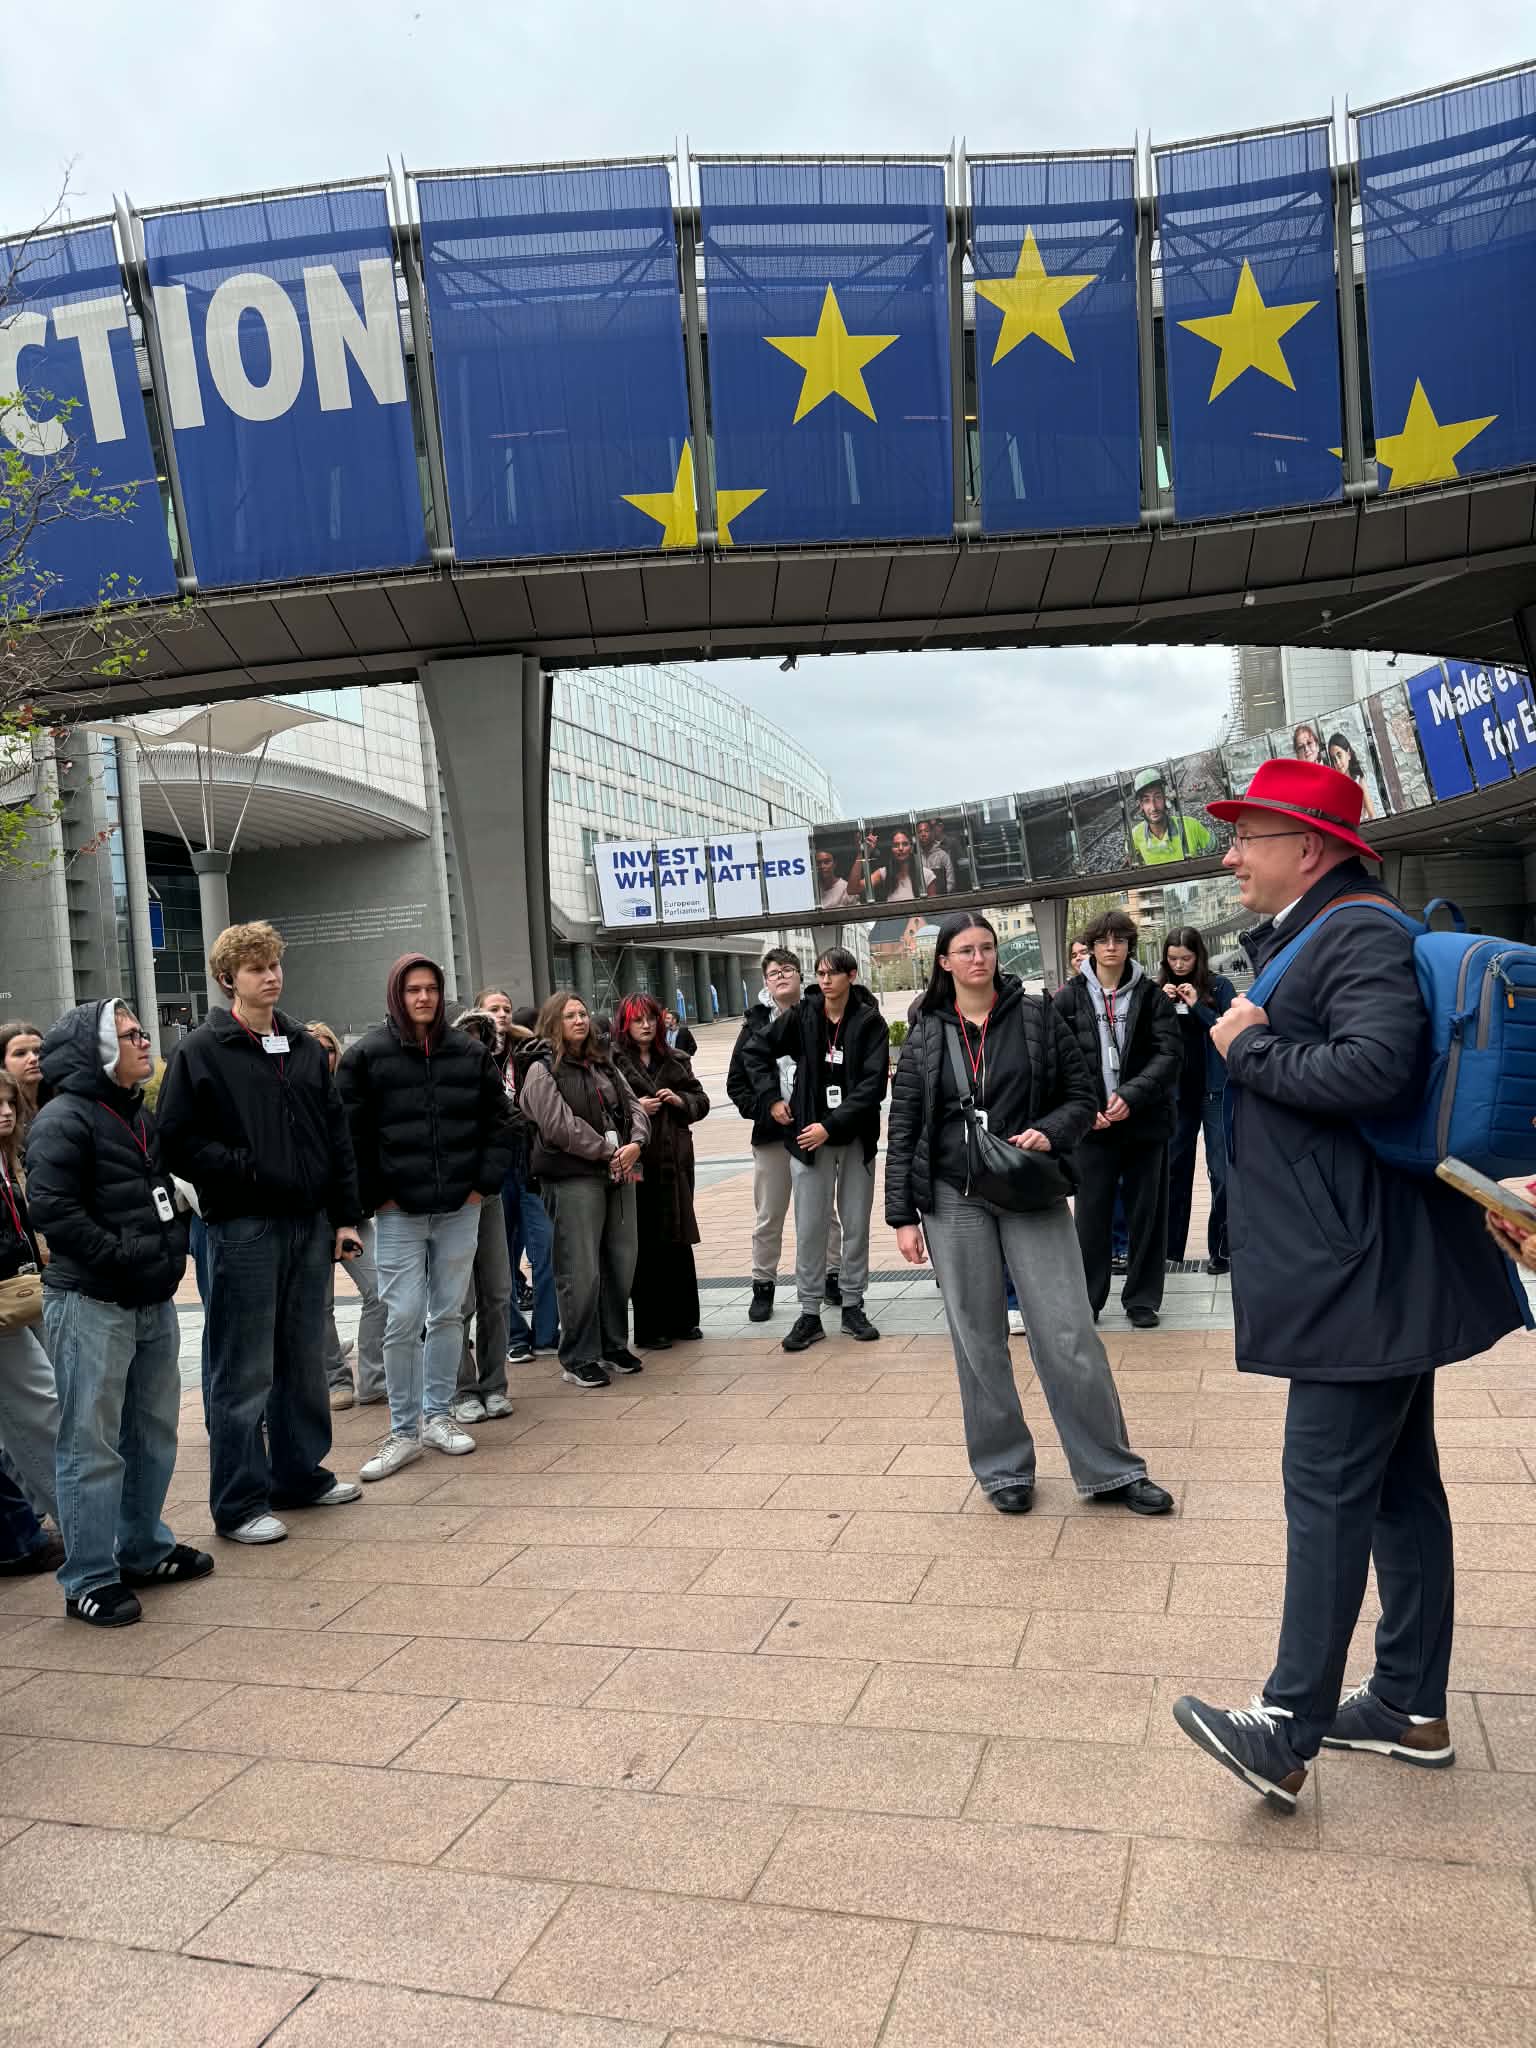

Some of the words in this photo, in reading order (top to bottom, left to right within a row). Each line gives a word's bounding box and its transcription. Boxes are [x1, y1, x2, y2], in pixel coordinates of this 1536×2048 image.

[0, 258, 408, 456] CTION
[1428, 669, 1495, 726] Make
[1483, 717, 1520, 761] for
[612, 847, 699, 869] INVEST
[708, 844, 734, 862] IN
[614, 869, 689, 890] WHAT
[695, 857, 806, 885] MATTERS
[663, 900, 701, 909] European
[663, 907, 705, 917] Parliament
